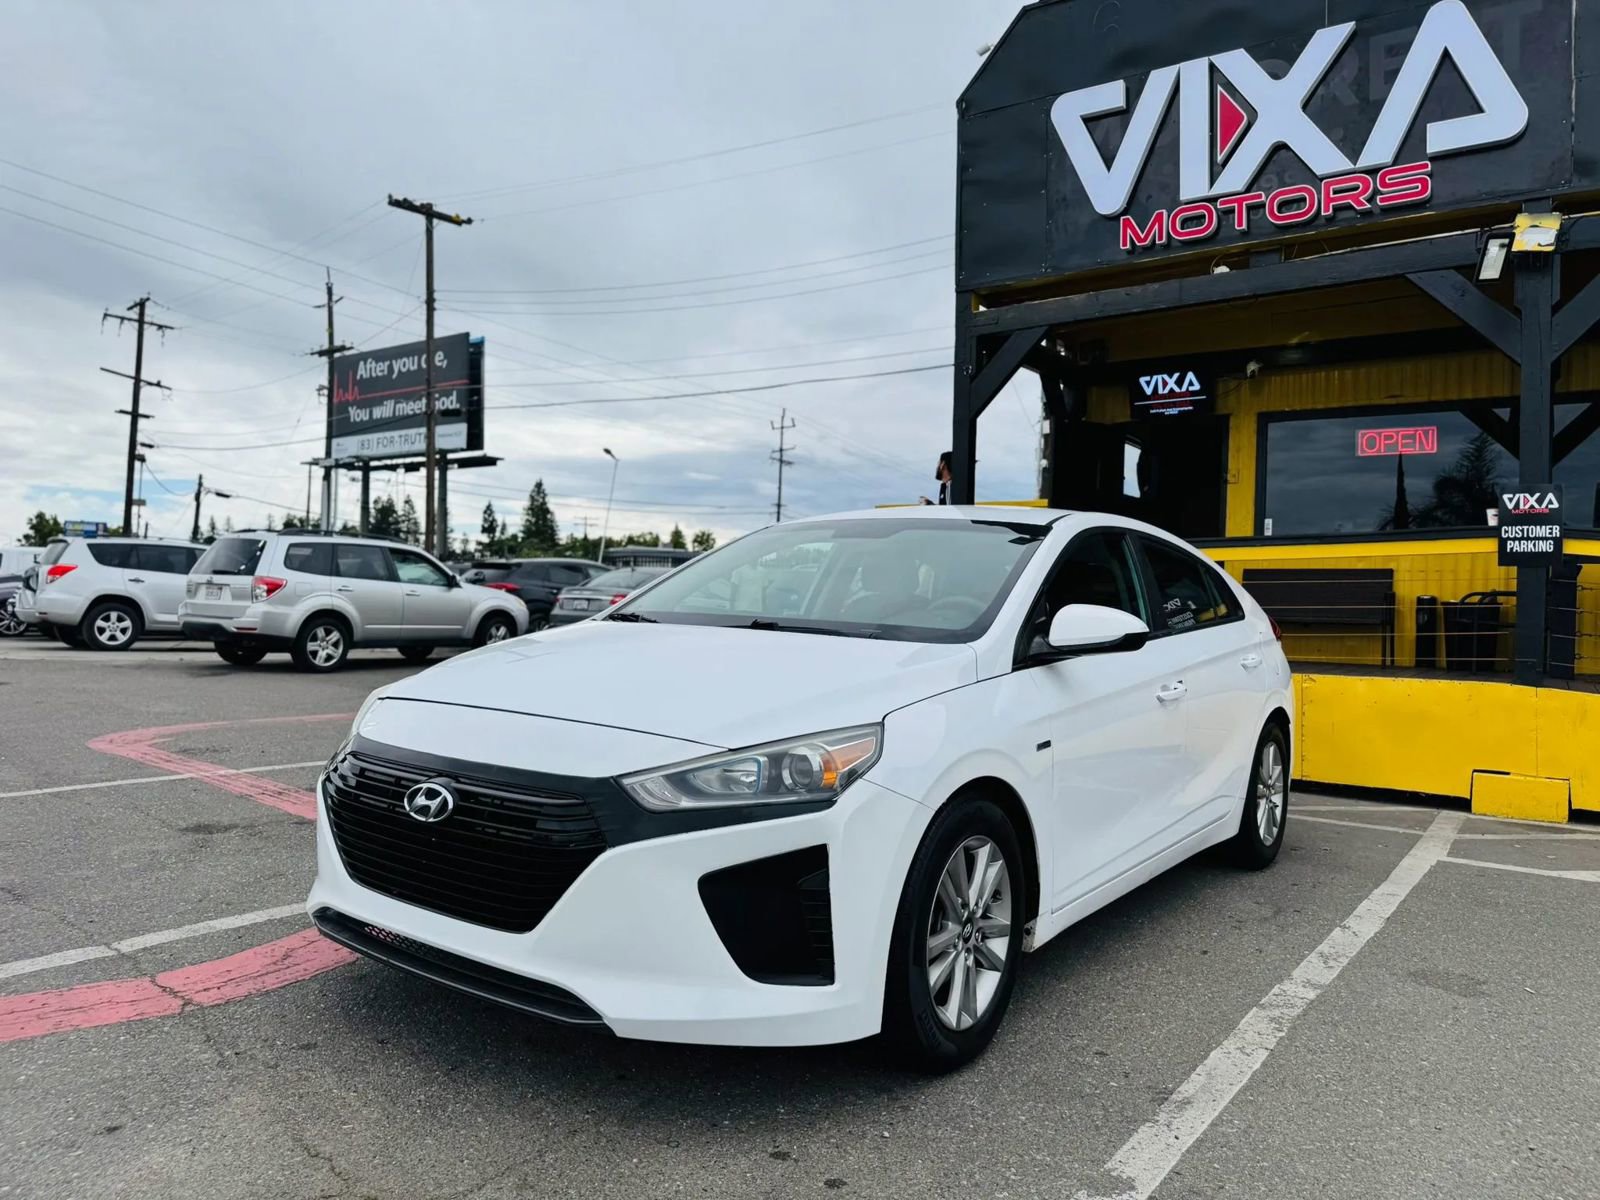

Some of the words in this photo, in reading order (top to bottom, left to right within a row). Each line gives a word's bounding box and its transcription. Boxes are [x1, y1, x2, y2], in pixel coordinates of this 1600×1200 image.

[1050, 0, 1529, 216] VIXA
[1119, 161, 1432, 250] MOTORS
[357, 358, 390, 380] After
[392, 355, 418, 379] you
[1139, 371, 1201, 395] VIXA
[348, 406, 370, 422] You
[372, 399, 395, 419] will
[395, 396, 427, 416] meet
[376, 431, 428, 448] FOR-TRUT
[1362, 430, 1433, 453] OPEN
[1502, 492, 1560, 510] VIXA
[1501, 525, 1560, 538] CUSTOMER
[1506, 540, 1554, 552] PARKING
